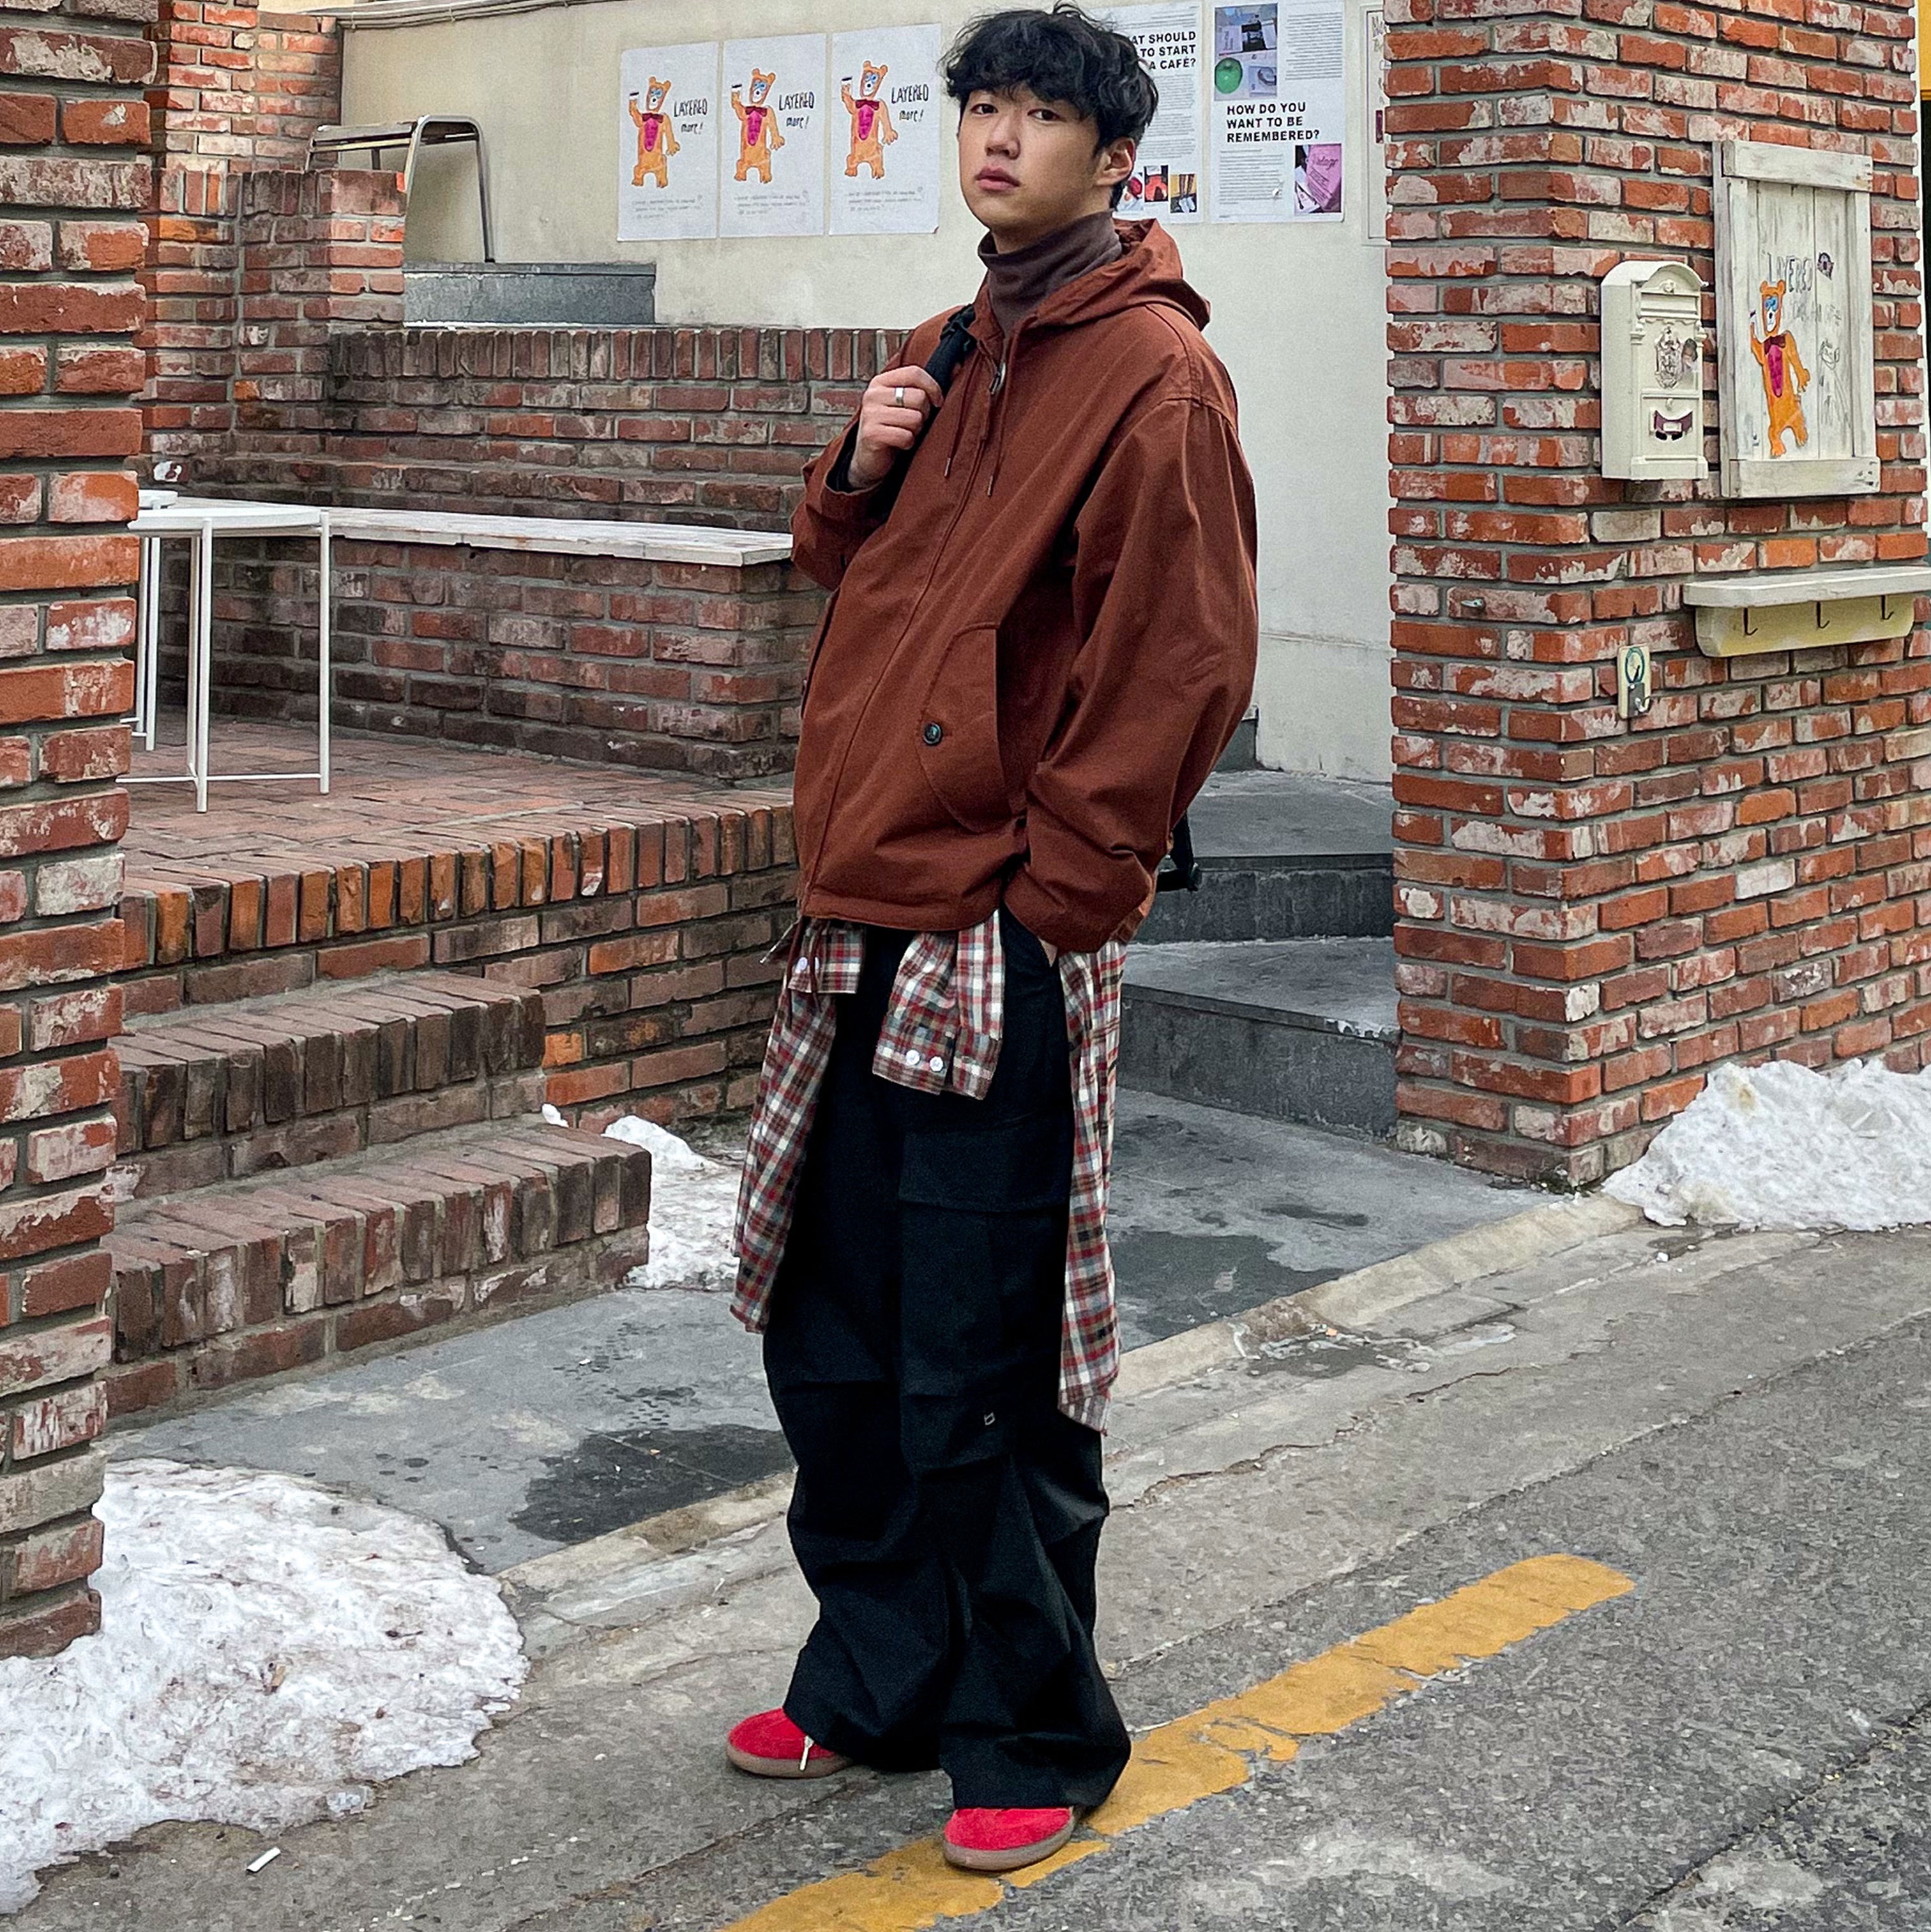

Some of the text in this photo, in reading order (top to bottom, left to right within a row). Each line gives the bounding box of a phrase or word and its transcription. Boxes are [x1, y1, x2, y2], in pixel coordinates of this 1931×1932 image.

[1132, 31, 1196, 45] AT SHOULD
[1140, 44, 1196, 57] TO START
[1149, 56, 1196, 70] A CAFÉ?
[778, 91, 815, 110] LAYERED
[891, 84, 928, 104] LAYERED
[674, 98, 708, 118] LAYERED
[1227, 102, 1306, 115] HOW DO YOU
[1227, 116, 1303, 129] WANT TO BE
[1227, 129, 1320, 142] REMEMBERED?
